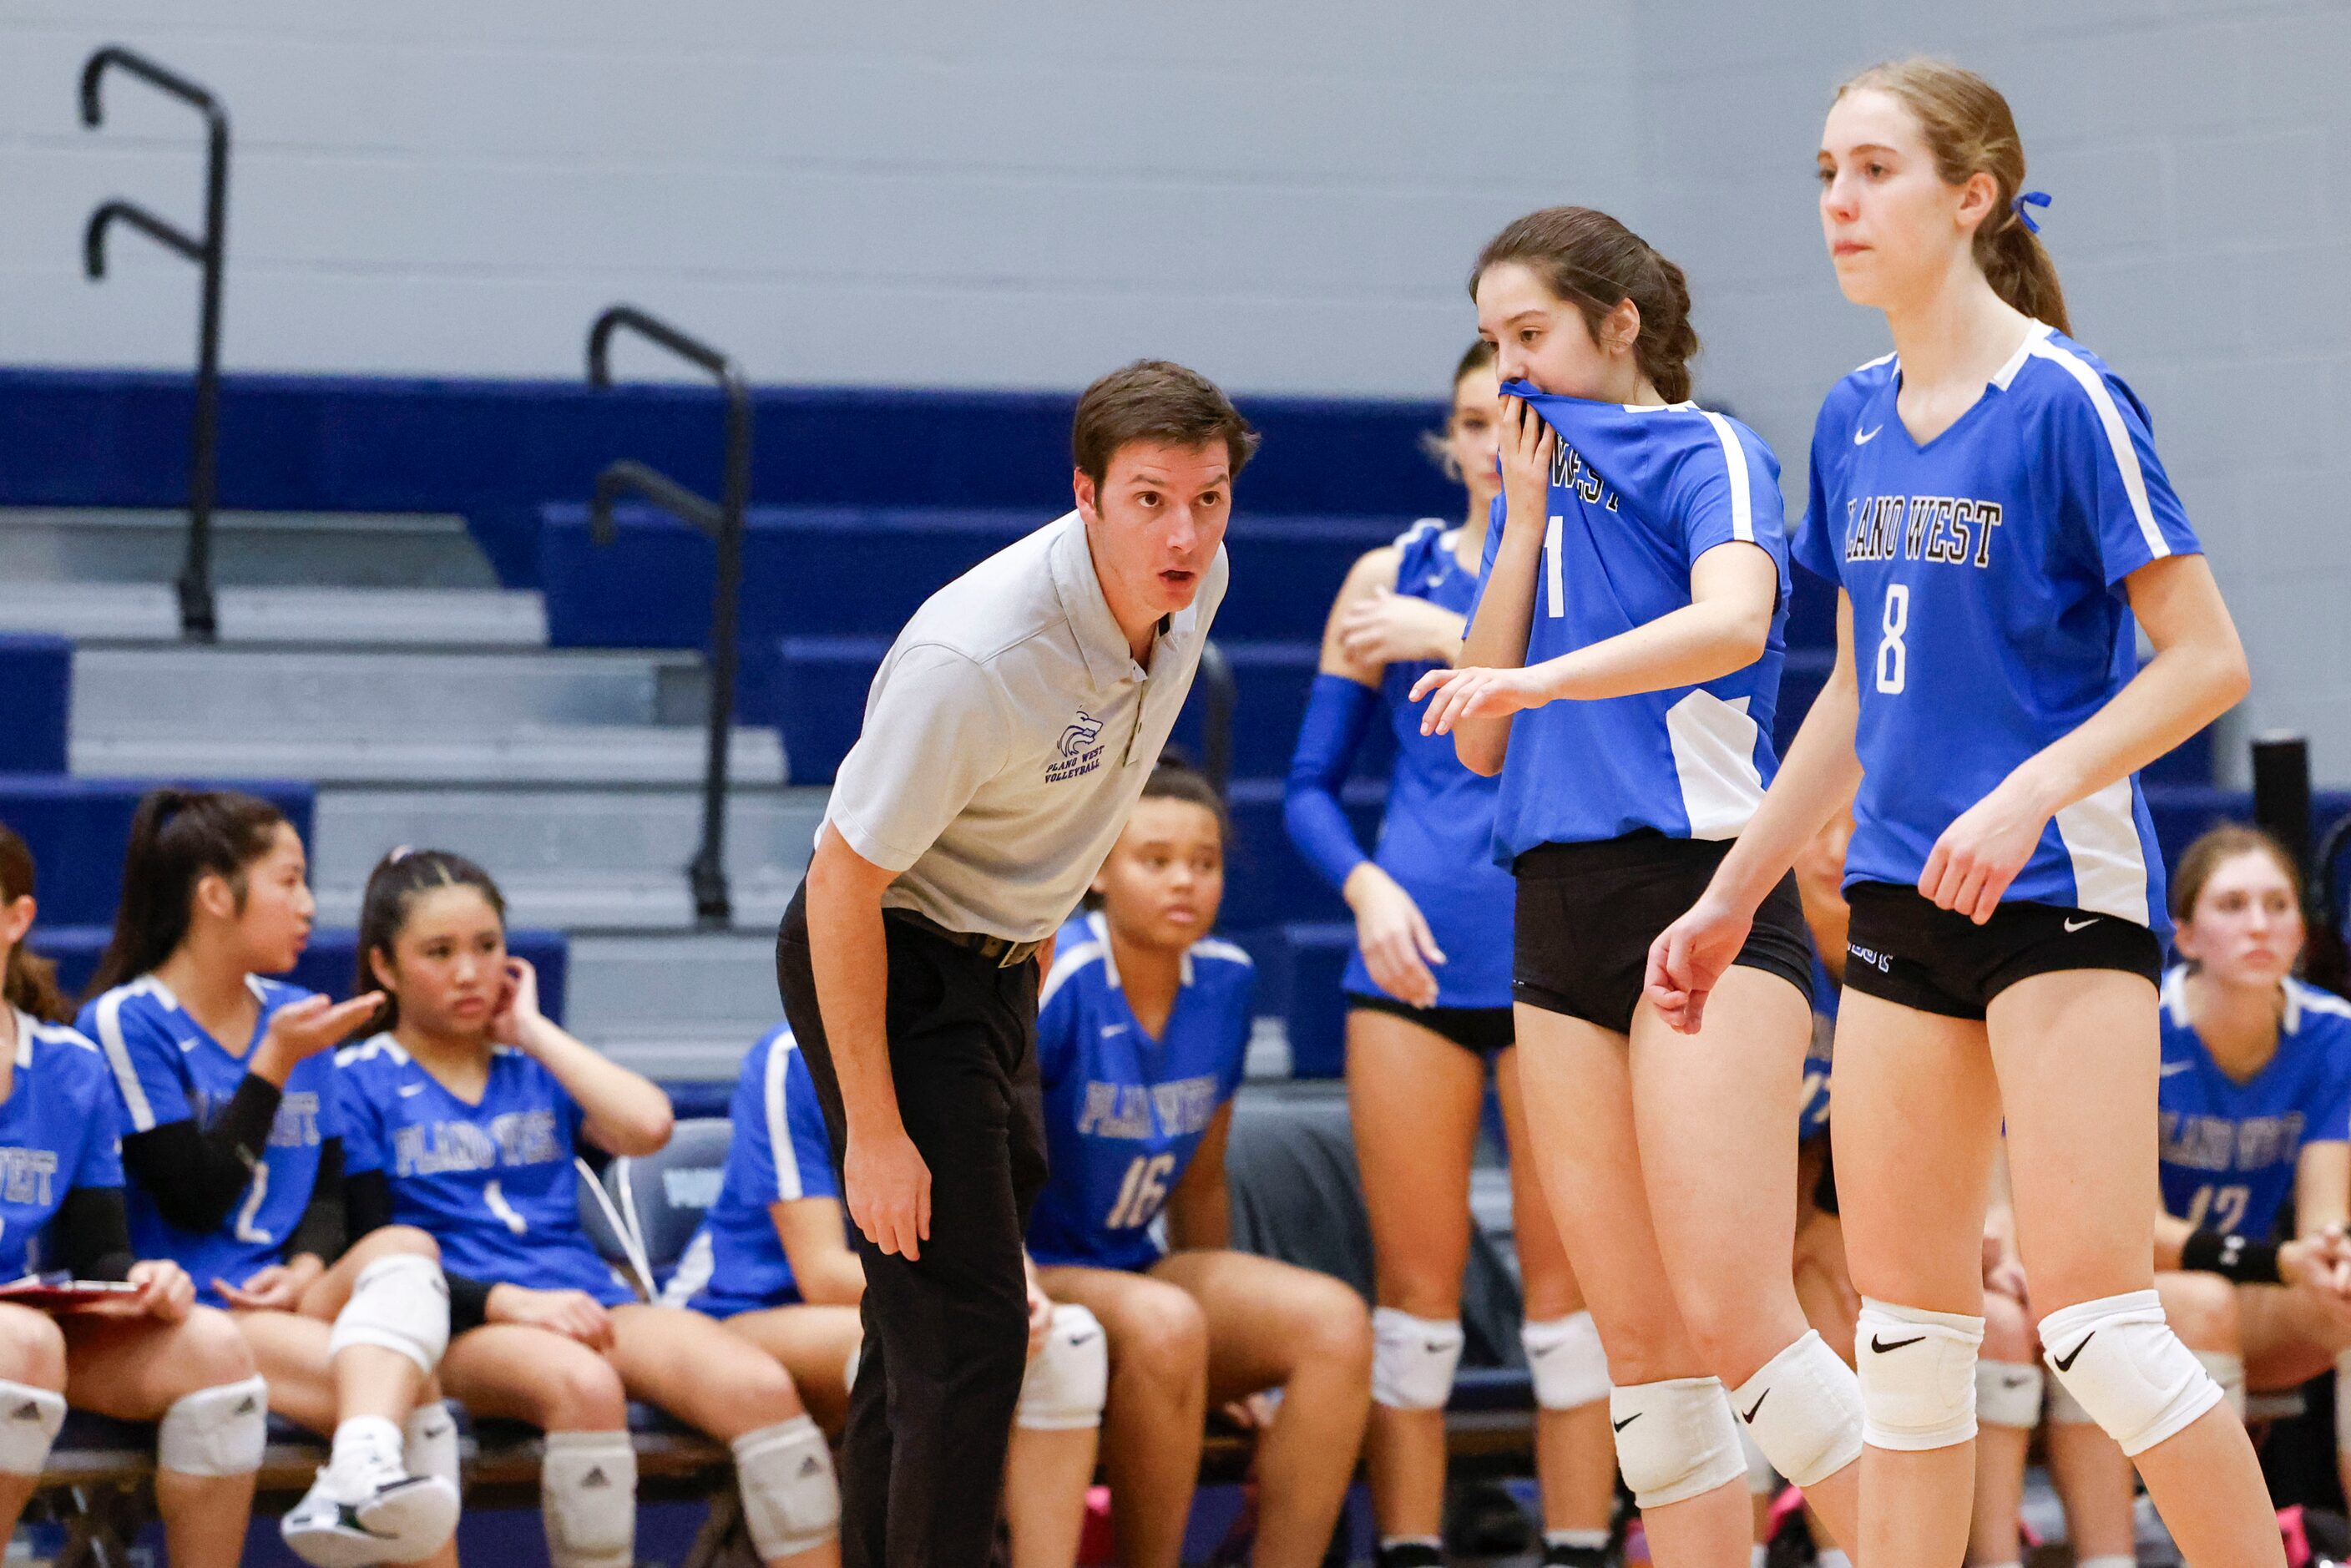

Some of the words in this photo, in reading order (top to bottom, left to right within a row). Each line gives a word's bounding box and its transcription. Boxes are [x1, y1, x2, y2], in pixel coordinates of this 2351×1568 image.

[1544, 515, 1565, 618] 1
[1905, 495, 2002, 569] WEST
[1876, 583, 1909, 695] 8
[1044, 758, 1100, 784] VOLLEYBALL
[1046, 757, 1078, 773] PLANO
[1081, 745, 1105, 763] WEST
